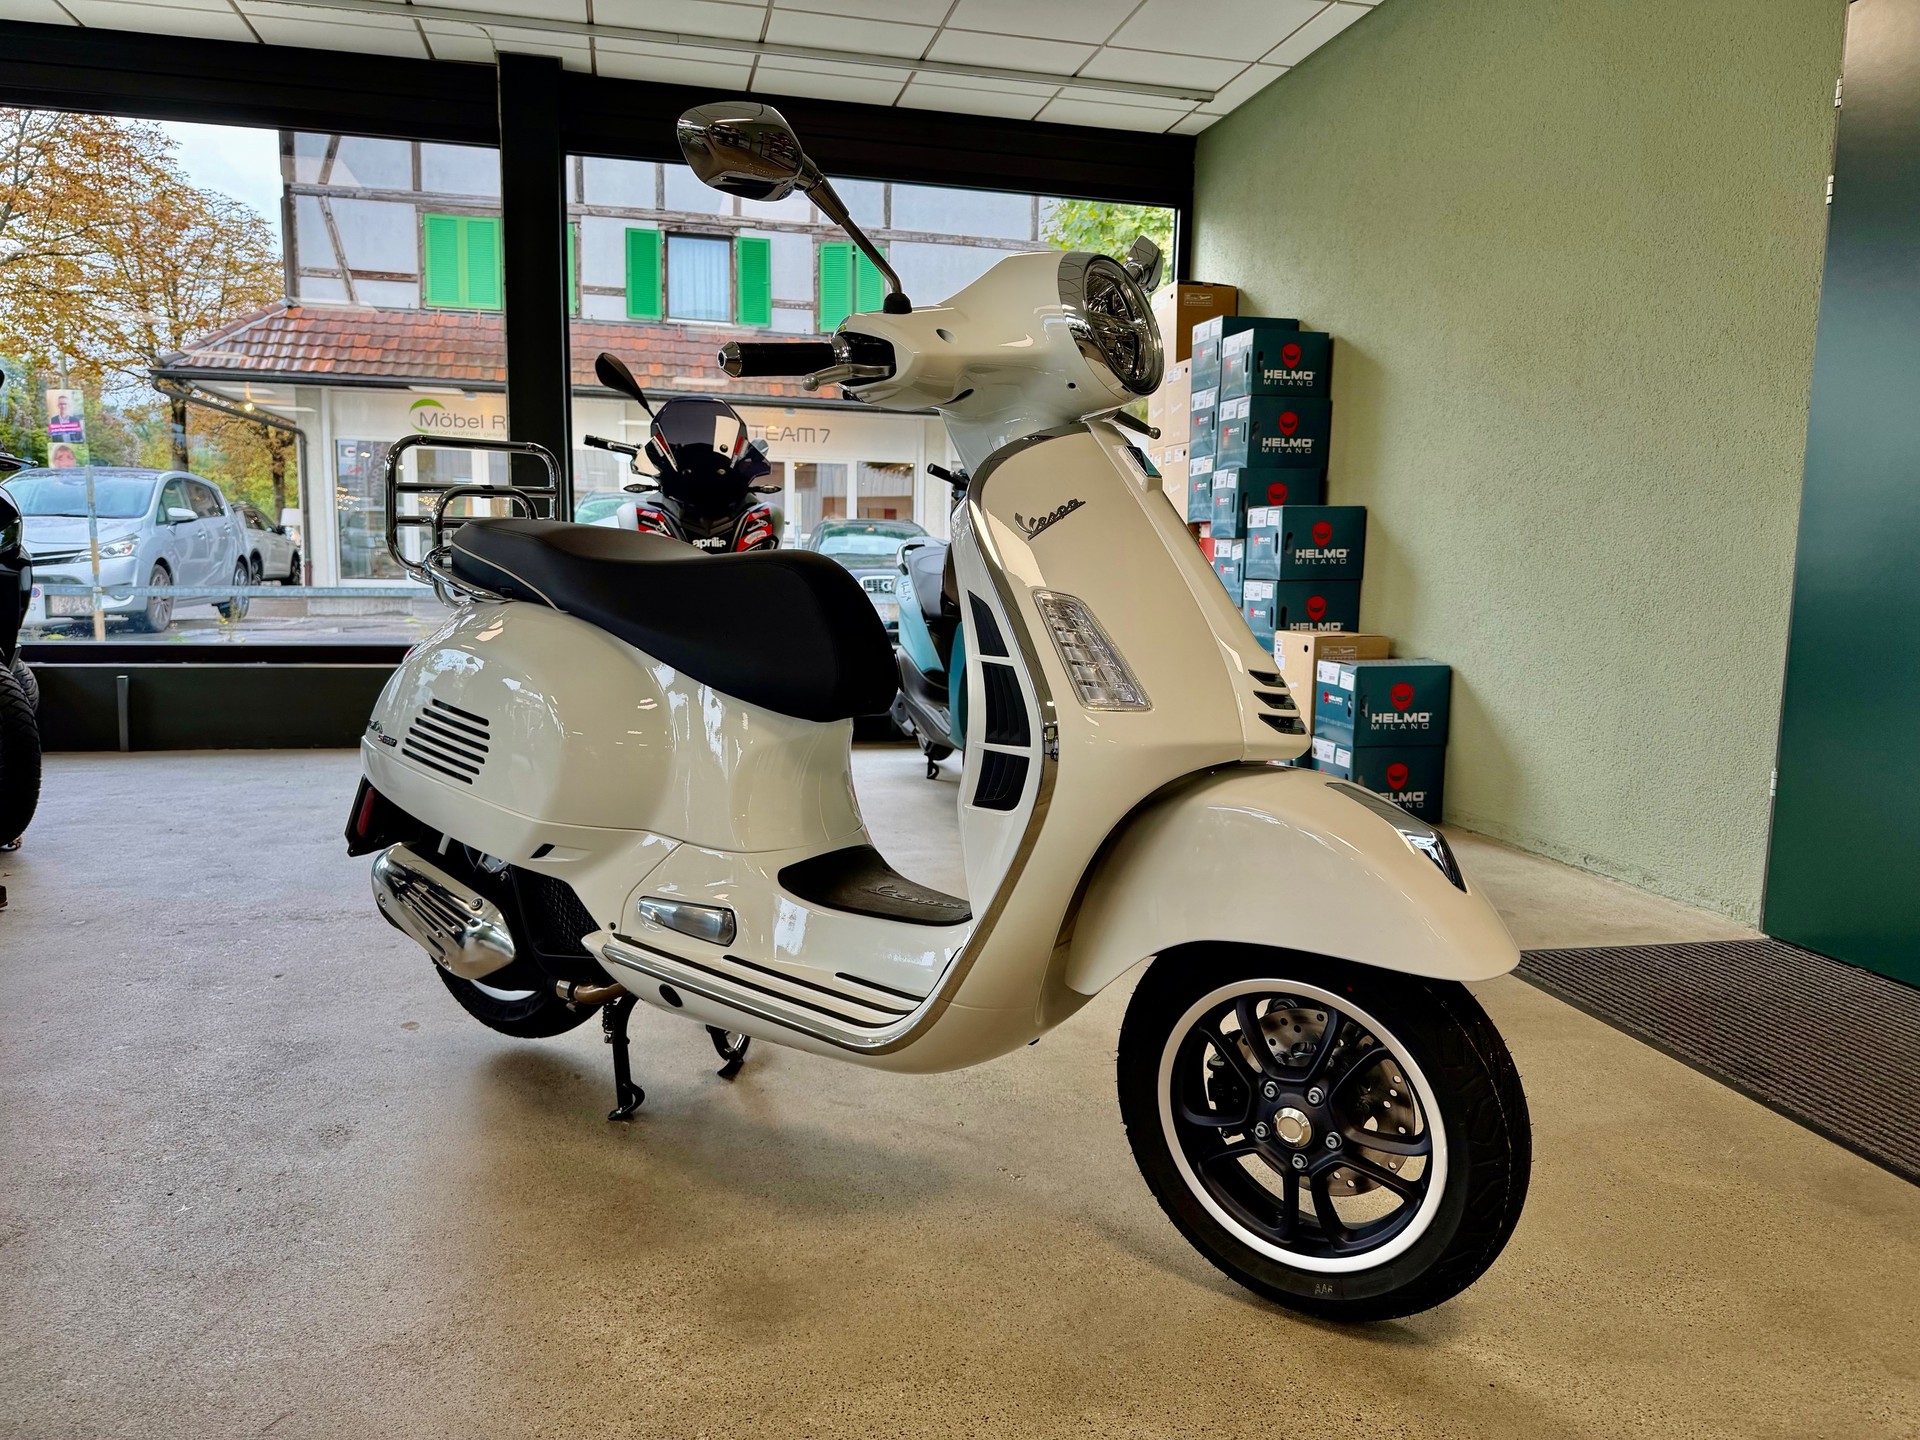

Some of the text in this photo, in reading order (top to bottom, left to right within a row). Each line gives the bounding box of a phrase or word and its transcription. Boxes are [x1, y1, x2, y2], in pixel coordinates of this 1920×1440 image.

[1263, 369, 1313, 380] HELMO
[1263, 379, 1313, 387] MILANO
[420, 411, 484, 429] Möbel
[749, 424, 831, 444] TEAM 7
[1262, 437, 1312, 448] HELMO
[1014, 498, 1086, 541] Vespa
[692, 537, 727, 549] aprilia
[1295, 548, 1347, 559] HELMO
[1289, 622, 1342, 631] HELMO
[1371, 712, 1430, 723] HELMO
[1370, 722, 1430, 730] MILANO
[1380, 791, 1424, 802] ELMO
